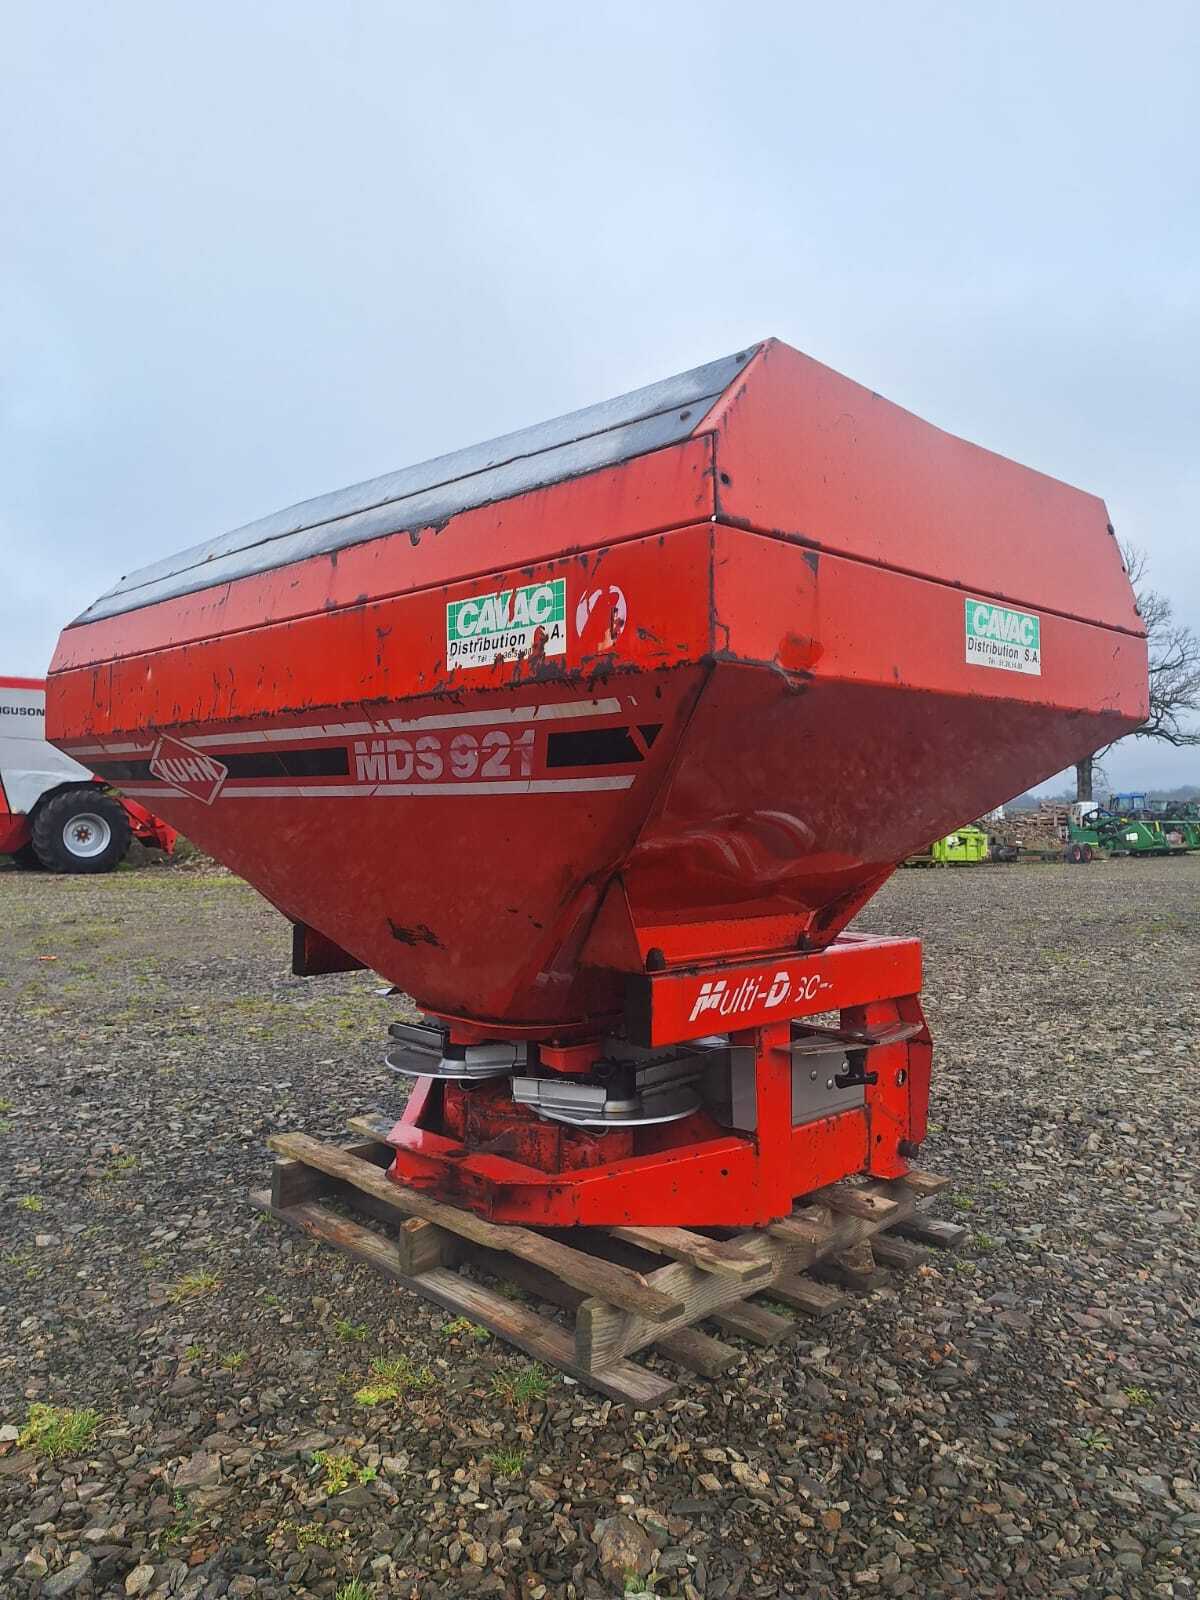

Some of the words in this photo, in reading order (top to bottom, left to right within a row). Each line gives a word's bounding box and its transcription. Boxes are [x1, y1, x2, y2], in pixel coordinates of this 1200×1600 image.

[457, 587, 553, 636] CAVAC
[973, 605, 1034, 645] CAVAC
[450, 632, 525, 656] Distribution
[967, 637, 1019, 659] Distribution
[1024, 648, 1040, 663] S.A.
[153, 757, 221, 783] KUHN
[354, 735, 444, 782] MDS
[451, 729, 536, 779] 921
